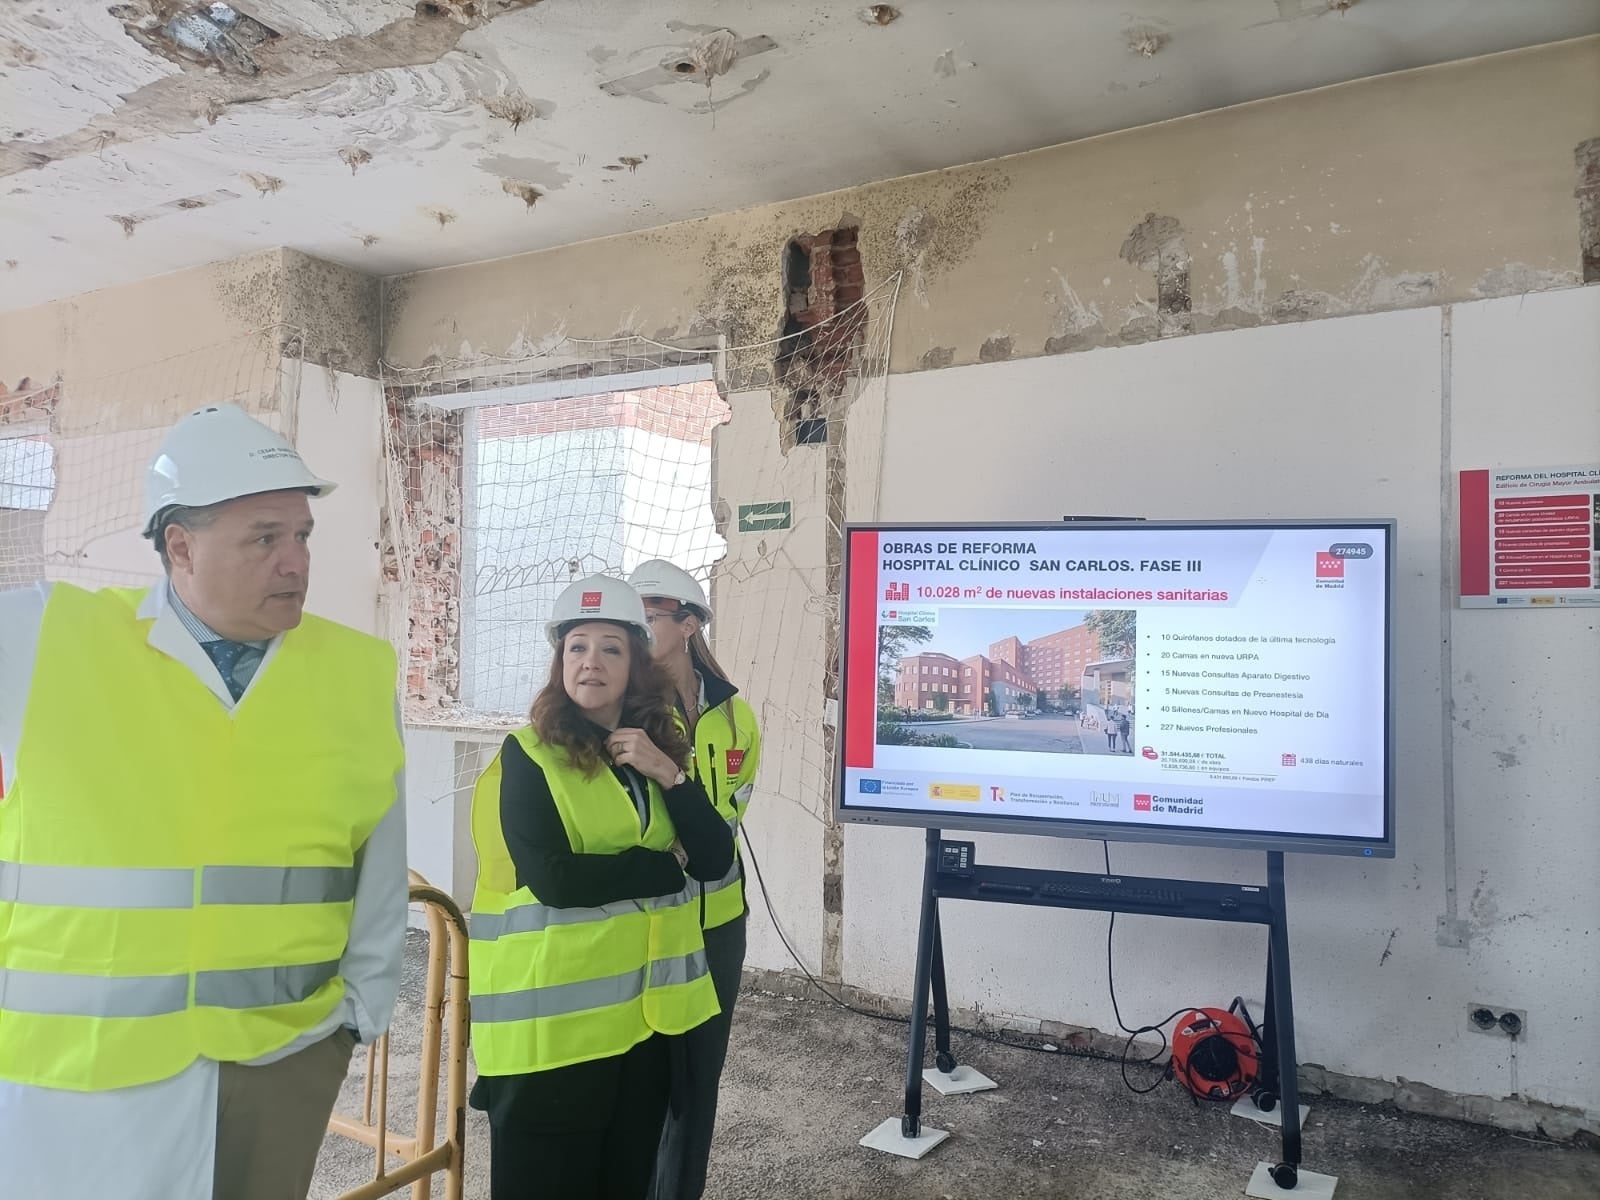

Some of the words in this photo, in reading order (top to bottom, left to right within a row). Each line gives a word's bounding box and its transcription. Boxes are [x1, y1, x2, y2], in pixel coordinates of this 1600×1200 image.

[883, 542, 933, 554] OBRAS
[937, 542, 957, 554] DE
[962, 542, 1037, 554] REFORMA
[1335, 547, 1367, 556] 274945
[882, 559, 954, 571] HOSPITAL
[958, 557, 1020, 571] CLÍNICO
[1029, 560, 1060, 572] SAN
[1065, 560, 1134, 572] CARLOS.
[1140, 560, 1181, 572] FASE
[1187, 560, 1202, 572] III
[917, 586, 960, 598] 10.028
[985, 587, 1003, 599] de
[1006, 589, 1056, 599] nuevas
[1059, 588, 1153, 600] instalaciones
[1157, 588, 1229, 601] sanitarias
[1161, 633, 1171, 641] 10
[1172, 633, 1213, 642] Quirófanos
[1215, 634, 1247, 642] dotados
[1248, 635, 1259, 643] de
[1260, 635, 1267, 643] la
[1269, 635, 1293, 643] última
[1172, 652, 1198, 660] Camas
[1236, 653, 1260, 661] URPA
[1172, 670, 1200, 678] Nuevas
[1201, 670, 1240, 679] Consultas
[1241, 672, 1272, 680] Aparato
[1274, 672, 1311, 681] Digestivo
[1172, 688, 1200, 696] Nuevas
[1201, 689, 1240, 697] Consultas
[1253, 690, 1304, 699] Preanestesia
[1160, 705, 1170, 713] 40
[1171, 705, 1230, 715] Sillones/Camas
[1243, 708, 1268, 716] Nuevo
[1269, 709, 1302, 718] Hospital
[1160, 723, 1174, 731] 227
[1176, 724, 1204, 732] Nuevos
[1206, 725, 1258, 735] Profesionales
[1330, 759, 1364, 767] naturales
[1152, 795, 1204, 805] Comunidad
[1152, 804, 1165, 812] de
[1168, 805, 1204, 815] Madrid
